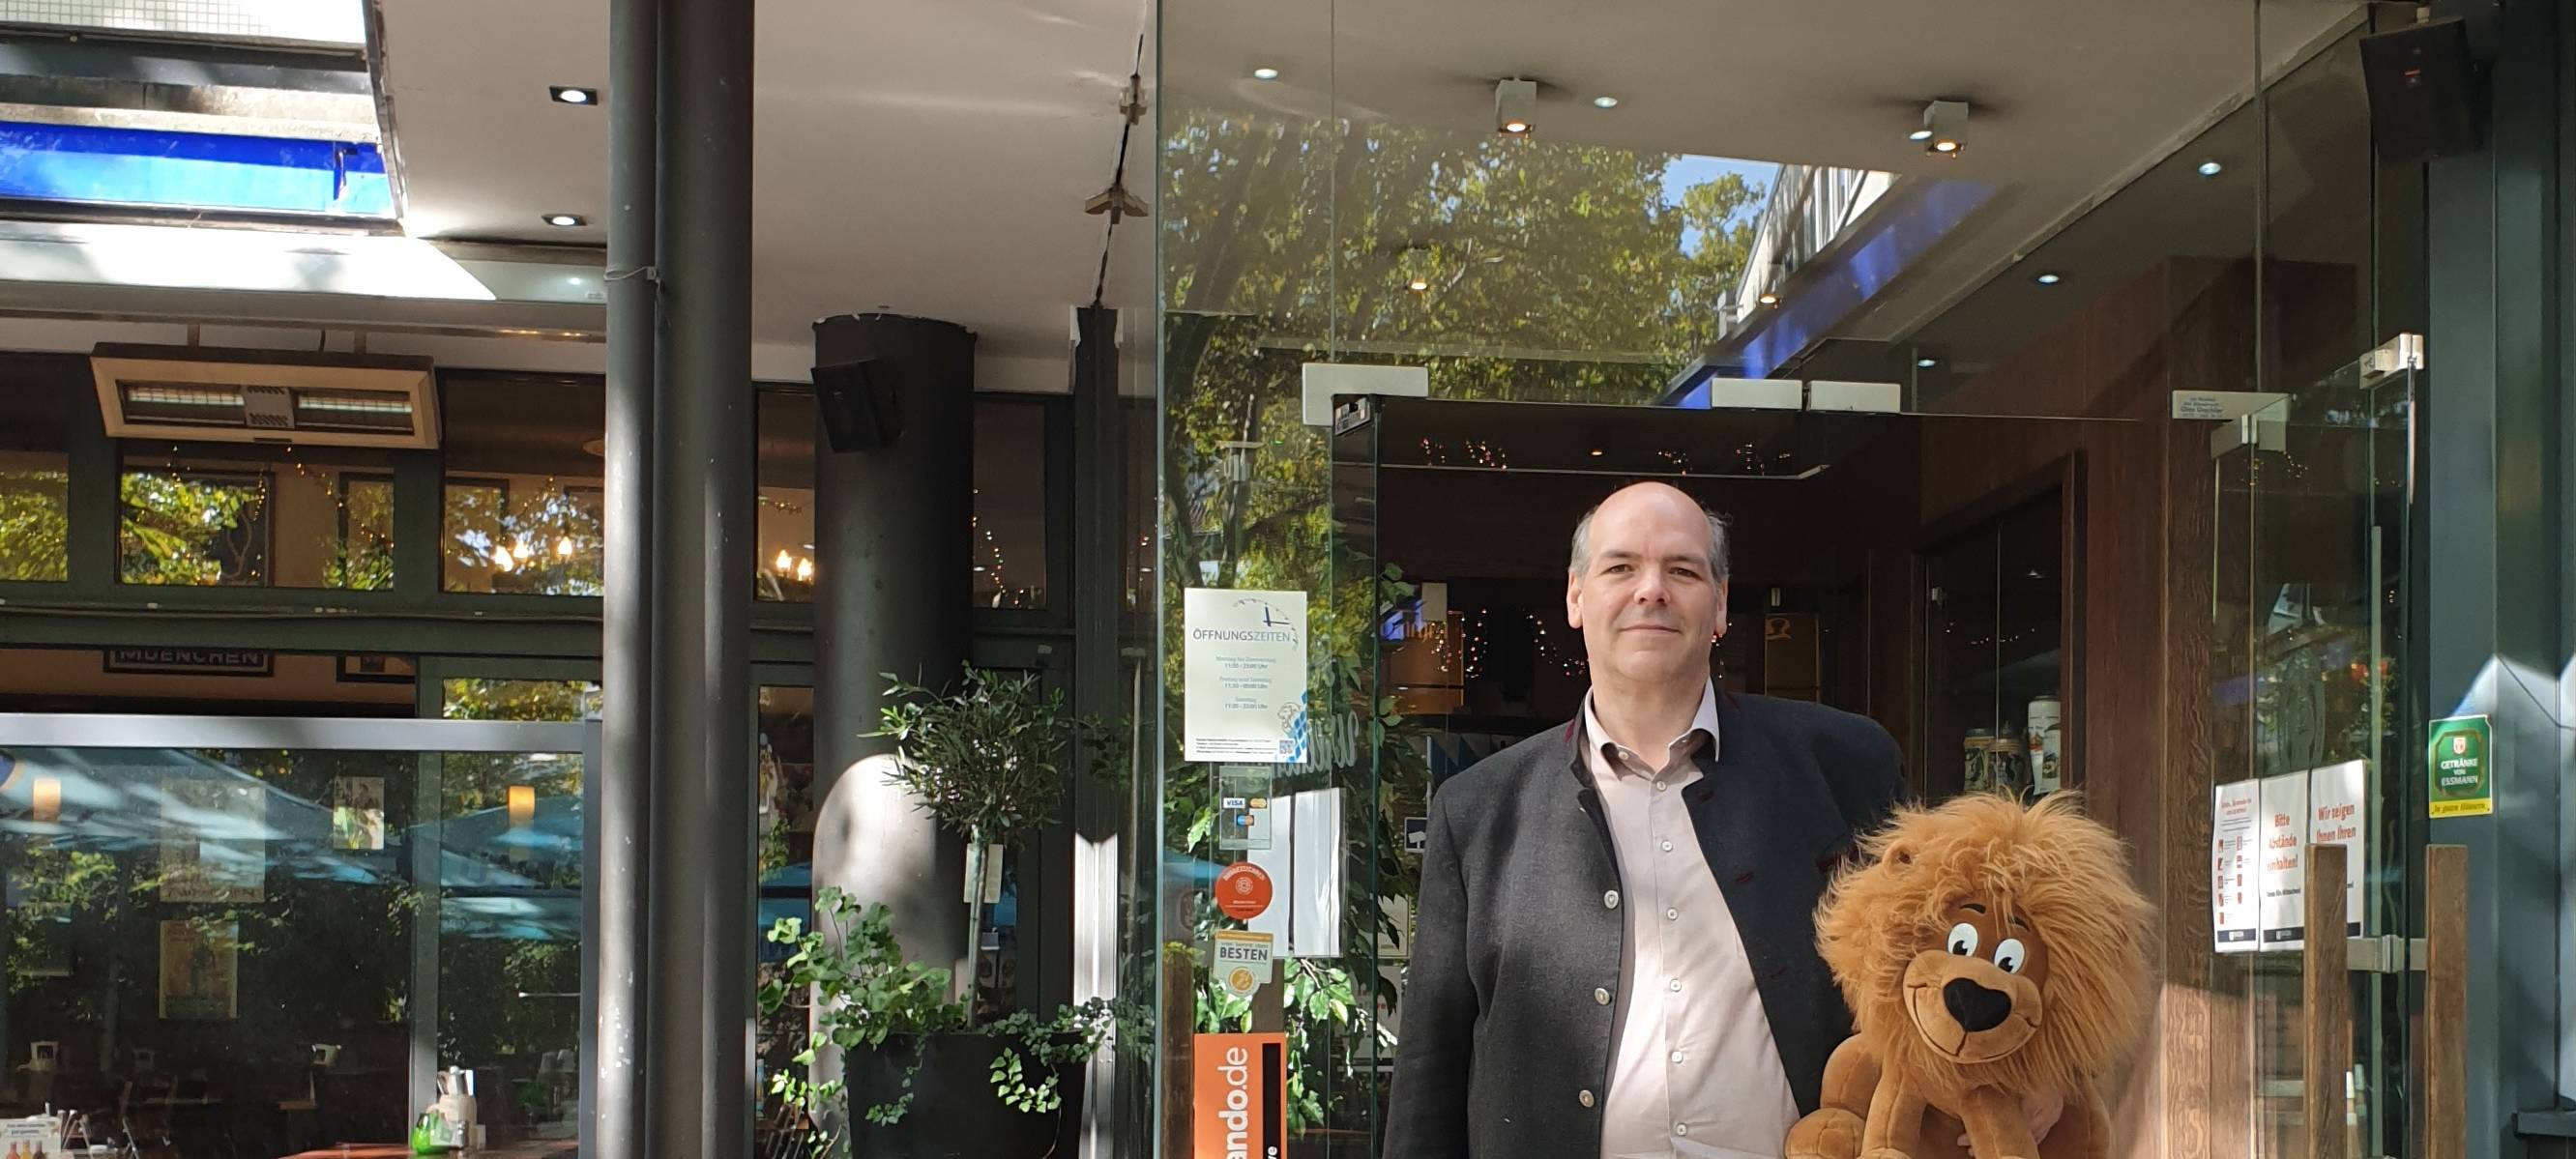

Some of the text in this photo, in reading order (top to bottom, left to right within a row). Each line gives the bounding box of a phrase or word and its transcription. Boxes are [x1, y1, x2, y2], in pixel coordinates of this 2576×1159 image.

[1192, 627, 1290, 642] ÖFFNUNGSZEITEN
[2441, 758, 2478, 769] GETRÄNKE
[2274, 811, 2291, 827] Bitte
[2318, 802, 2356, 821] Wir zeigen
[2337, 826, 2356, 840] Ihren
[1219, 946, 1268, 961] BESTEN
